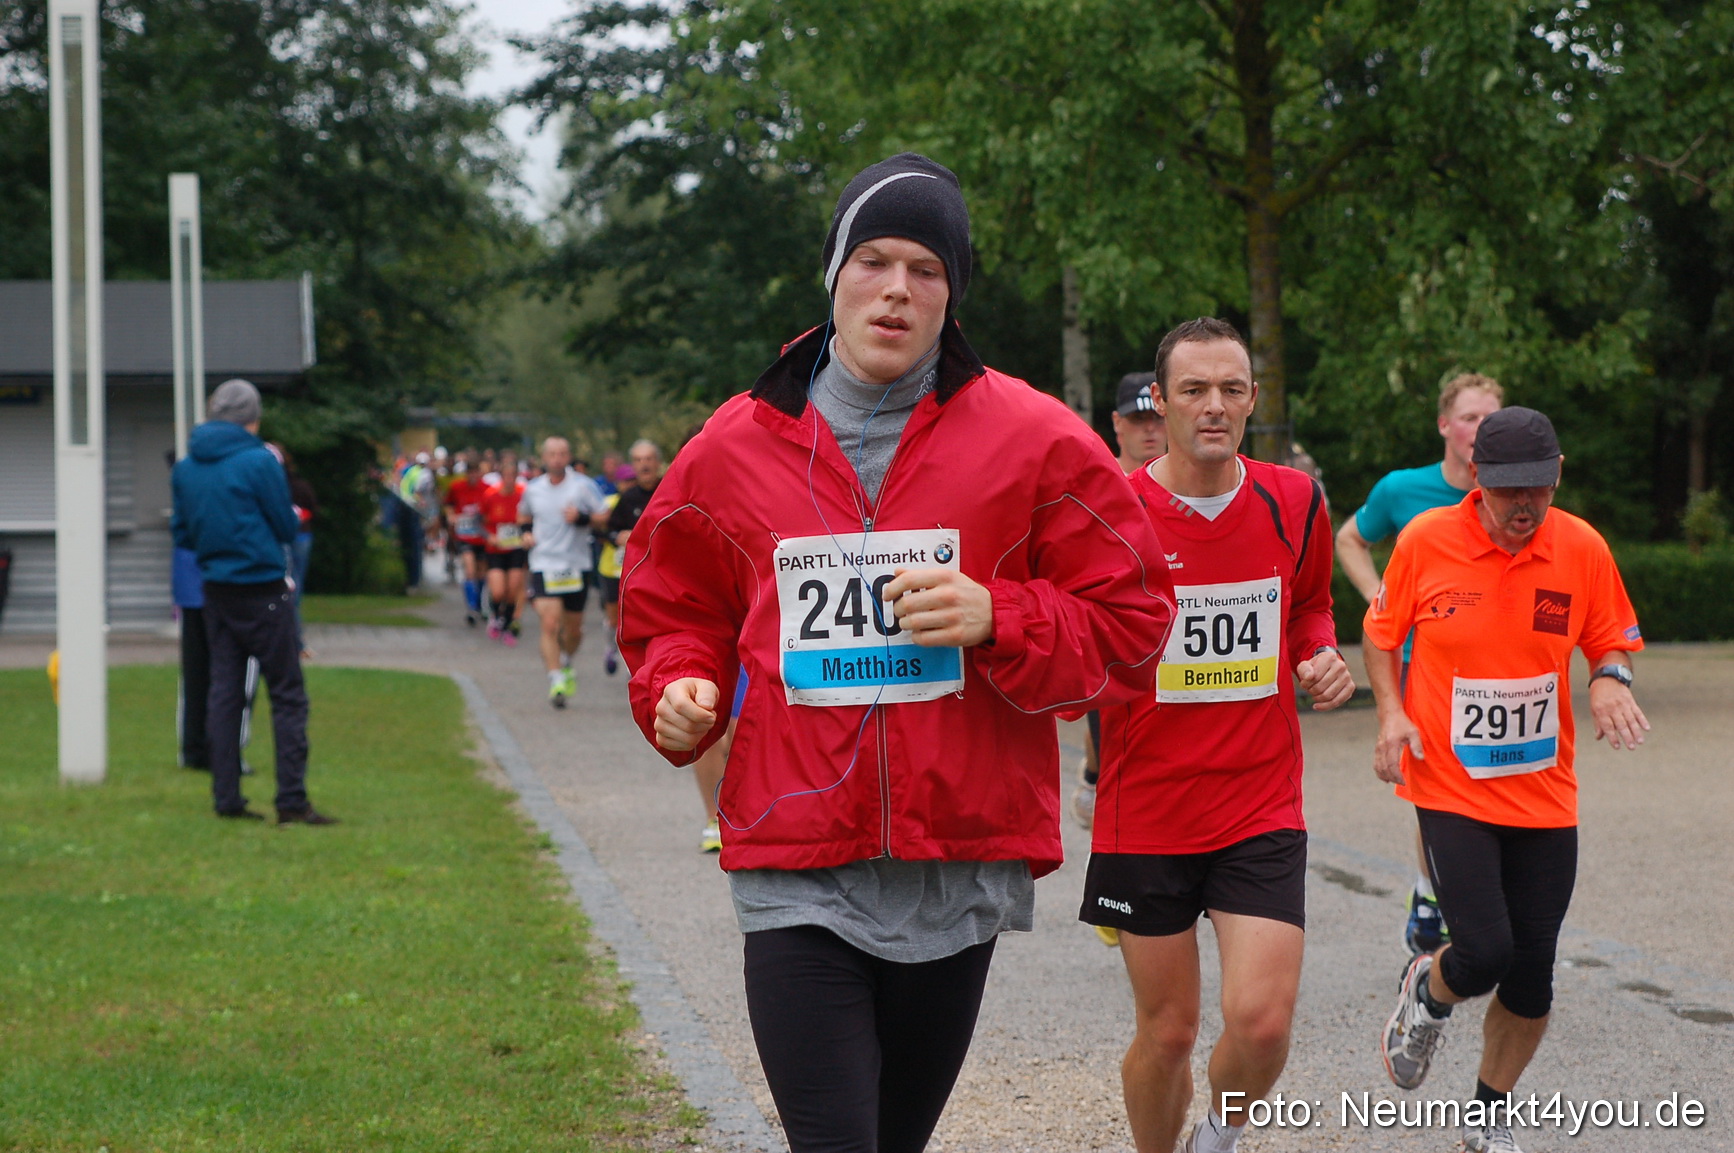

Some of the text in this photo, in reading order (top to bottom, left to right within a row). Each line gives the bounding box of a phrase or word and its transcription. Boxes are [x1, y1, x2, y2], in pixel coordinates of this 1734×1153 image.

[779, 554, 837, 572] PARTL
[843, 549, 926, 567] Neumarkt
[1177, 598, 1201, 609] RTL
[1205, 593, 1262, 608] Neumarkt
[1184, 611, 1261, 657] 504
[822, 655, 922, 682] Matthias
[1185, 665, 1259, 686] Bernhard
[1455, 688, 1490, 699] PARTL
[1493, 687, 1542, 699] Neumarkt
[1464, 698, 1549, 740] 2917
[1490, 750, 1525, 764] Hans
